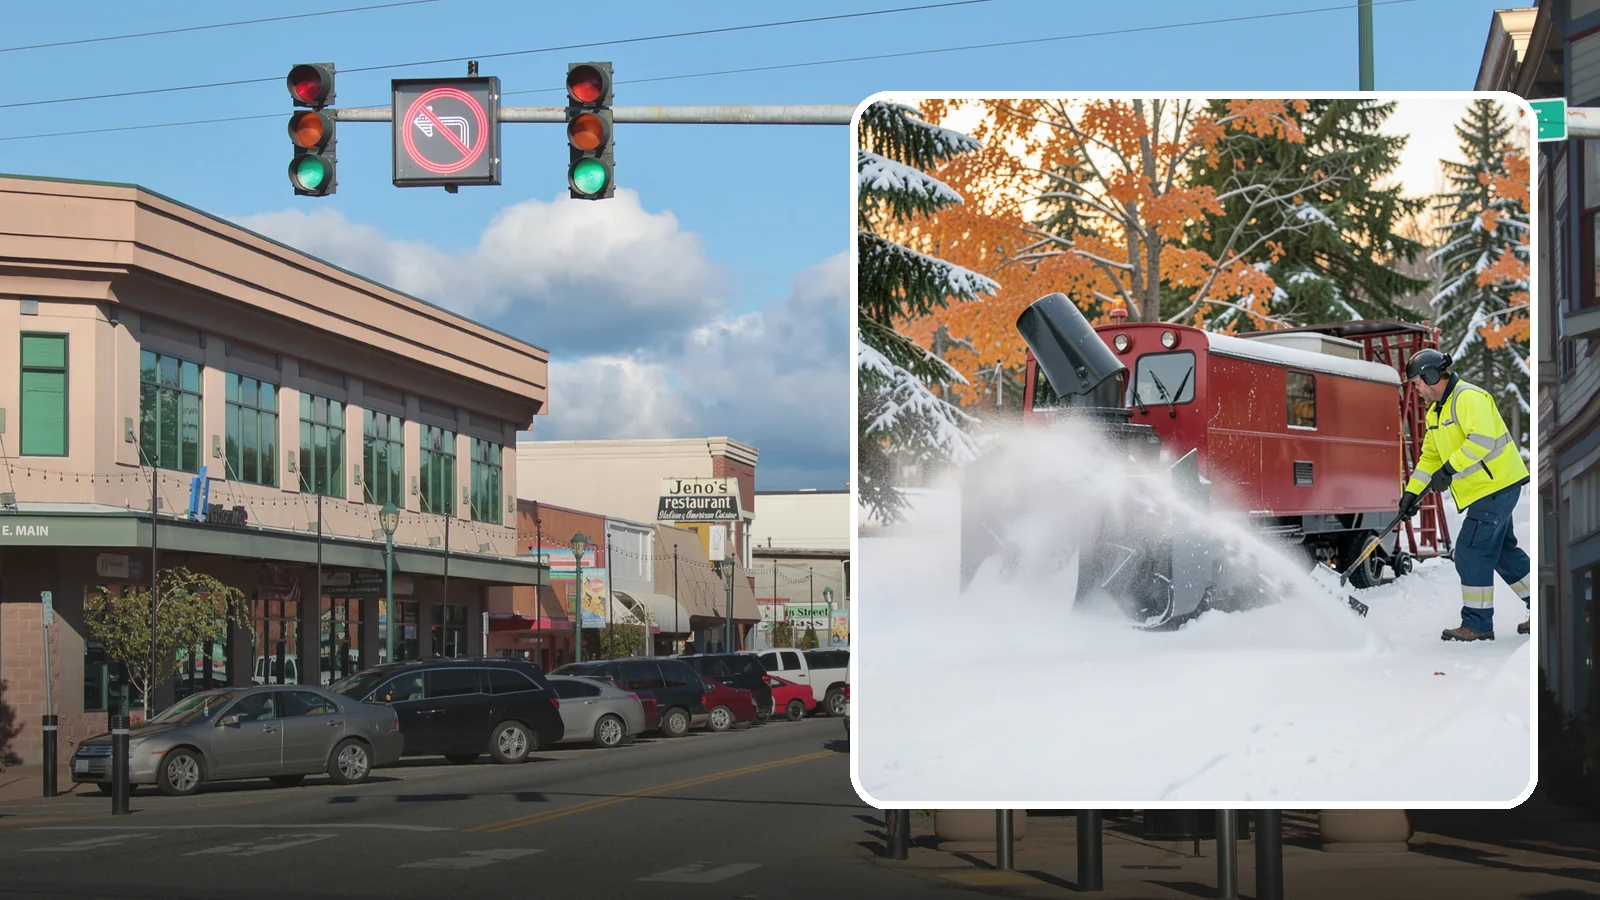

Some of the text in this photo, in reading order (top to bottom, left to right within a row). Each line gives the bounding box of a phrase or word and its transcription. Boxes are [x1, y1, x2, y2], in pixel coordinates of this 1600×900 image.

[670, 480, 728, 494] Jeno's
[665, 496, 730, 508] restaurant
[658, 510, 682, 520] Italian
[686, 510, 714, 519] American
[715, 509, 737, 519] Cuisine
[2, 525, 49, 536] E. MAIN
[797, 607, 829, 616] Street
[790, 619, 824, 627] lass
